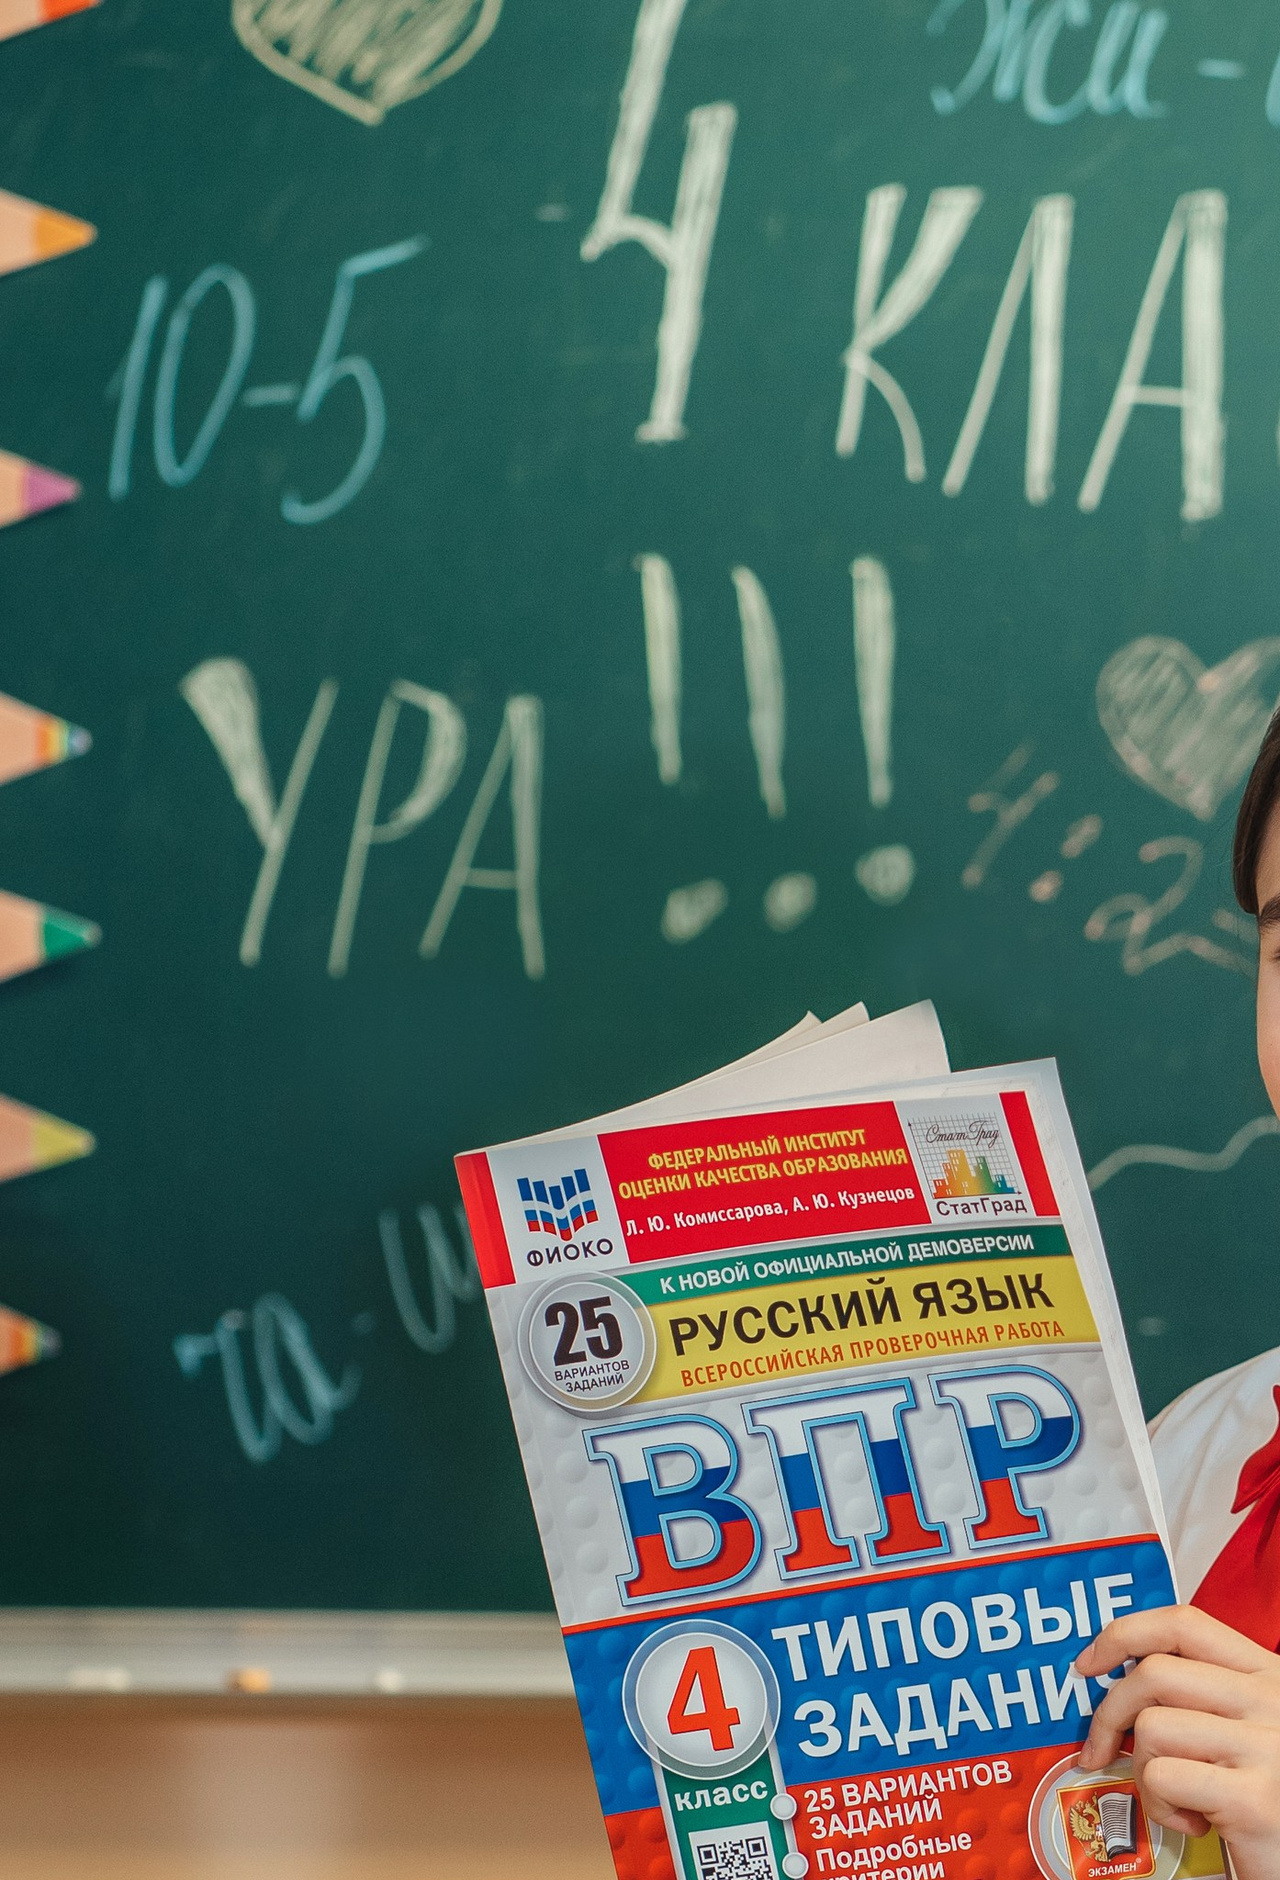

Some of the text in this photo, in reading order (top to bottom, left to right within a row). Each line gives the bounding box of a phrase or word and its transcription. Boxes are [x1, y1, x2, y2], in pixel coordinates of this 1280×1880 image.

[581, 0, 737, 443] 4
[108, 235, 427, 525] 10-5
[178, 655, 548, 982] УРА
[618, 1148, 909, 1200] ОЦЕНКИ КАЧЕСТВА ОБРАЗОВАНИЯ
[648, 1128, 866, 1170] ФЕДЕРАЛЬНЫЙ ИНСТИТУТ
[626, 1187, 915, 1237] Л. Ю. Комиссарова, А. Ю. Кузнецов
[936, 1197, 1028, 1216] СтатГрад
[526, 1238, 614, 1267] ФИОКО
[660, 1234, 1035, 1295] К НОВОЙ ОФИЦИАЛЬНОЙ ДЕМОВЕРСИИ
[544, 1295, 623, 1367] 25
[668, 1272, 1056, 1357] РУССКИЙ ЯЗЫК
[554, 1360, 631, 1382] ВАРИАНТОВ
[680, 1319, 1066, 1388] ВСЕРОССИЙСКАЯ ПРОВЕРОЧНАЯ РАБОТА
[565, 1372, 625, 1394] ЗАДАНИЙ
[583, 1364, 1082, 1607] ВПР
[771, 1572, 1134, 1683] ТИПОВЫЕ
[666, 1645, 741, 1753] 4
[792, 1656, 1140, 1759] ЗАДАНИ
[674, 1780, 769, 1812] класс
[803, 1760, 1013, 1814] 25 ВАРИАНТОВ
[808, 1793, 943, 1840] ЗАДАНИЙ
[815, 1831, 973, 1872] Подробные
